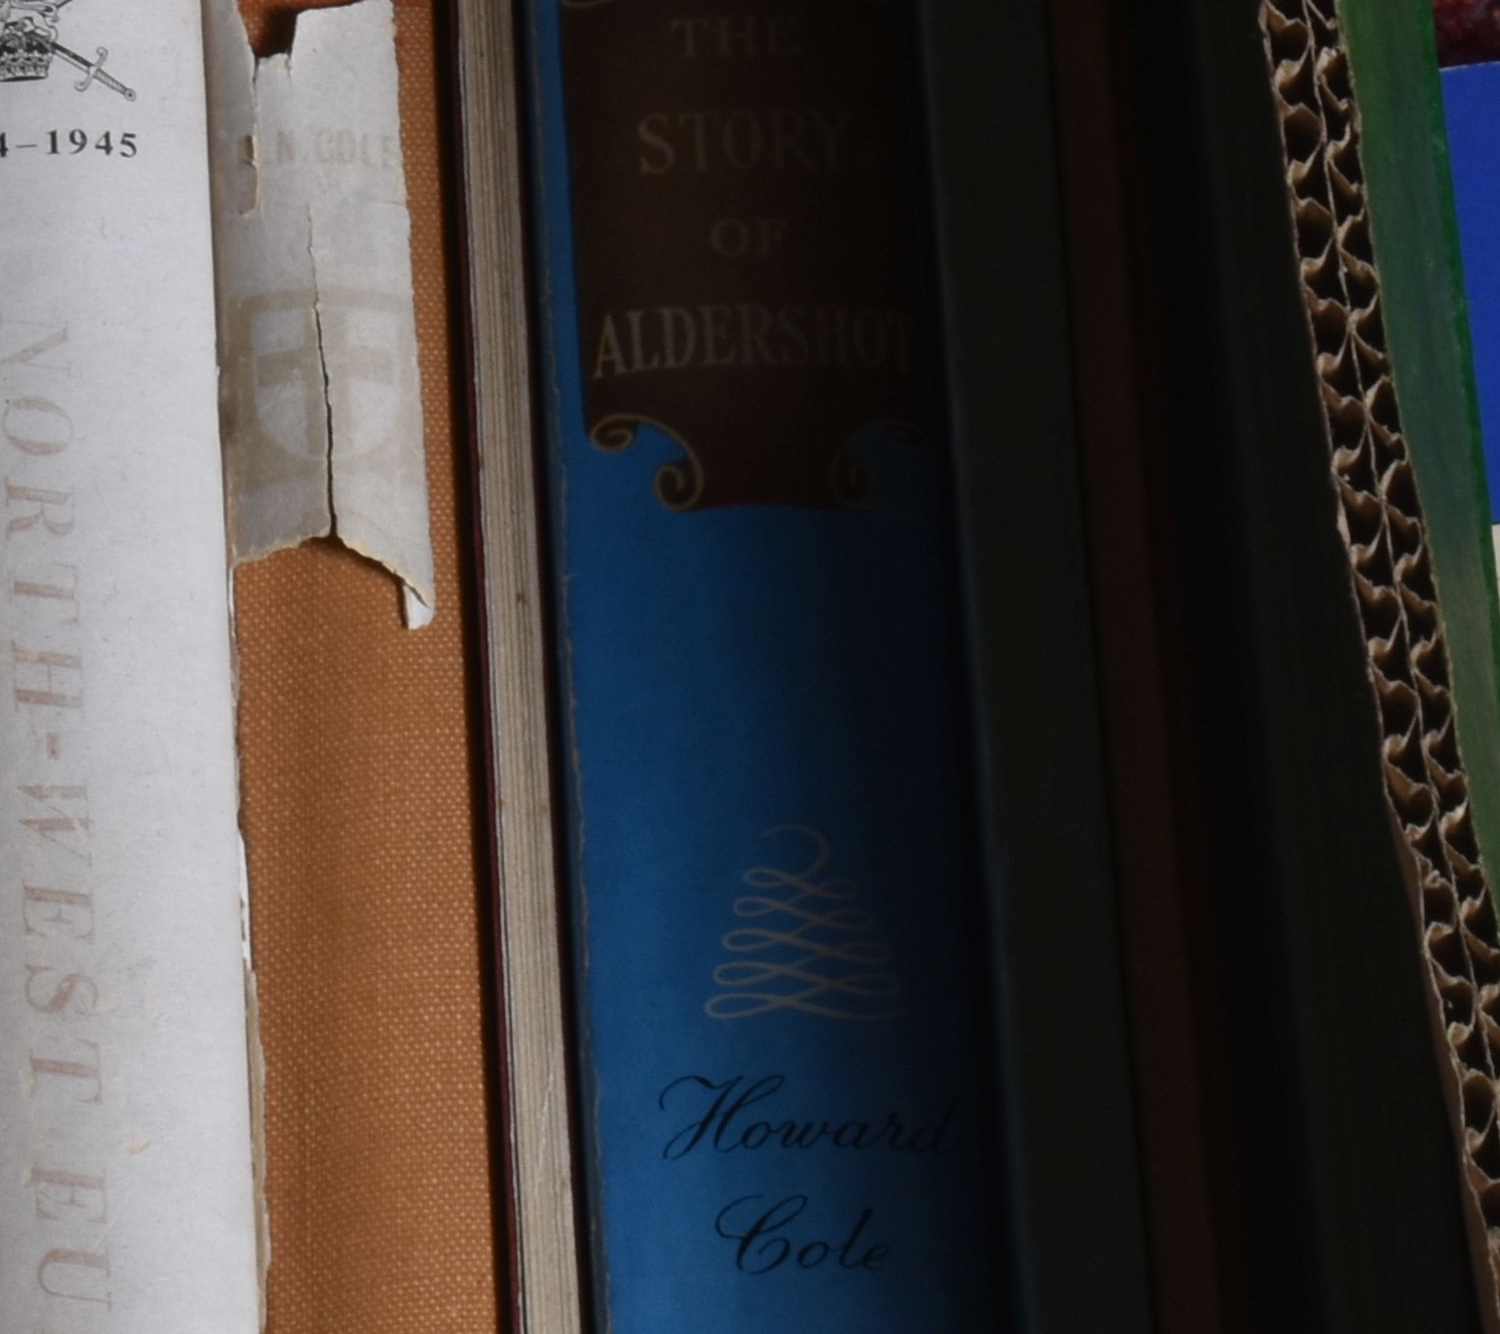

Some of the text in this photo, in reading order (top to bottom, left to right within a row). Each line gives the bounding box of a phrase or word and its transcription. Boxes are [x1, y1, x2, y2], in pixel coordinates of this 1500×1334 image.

[670, 16, 804, 59] THE
[637, 109, 853, 175] STORY
[709, 217, 790, 259] OF
[591, 301, 918, 380] ALDERSHOT
[0, 315, 105, 1108] NORTH-WEST
[657, 1073, 964, 1162] Howard
[715, 1193, 893, 1276] Cole
